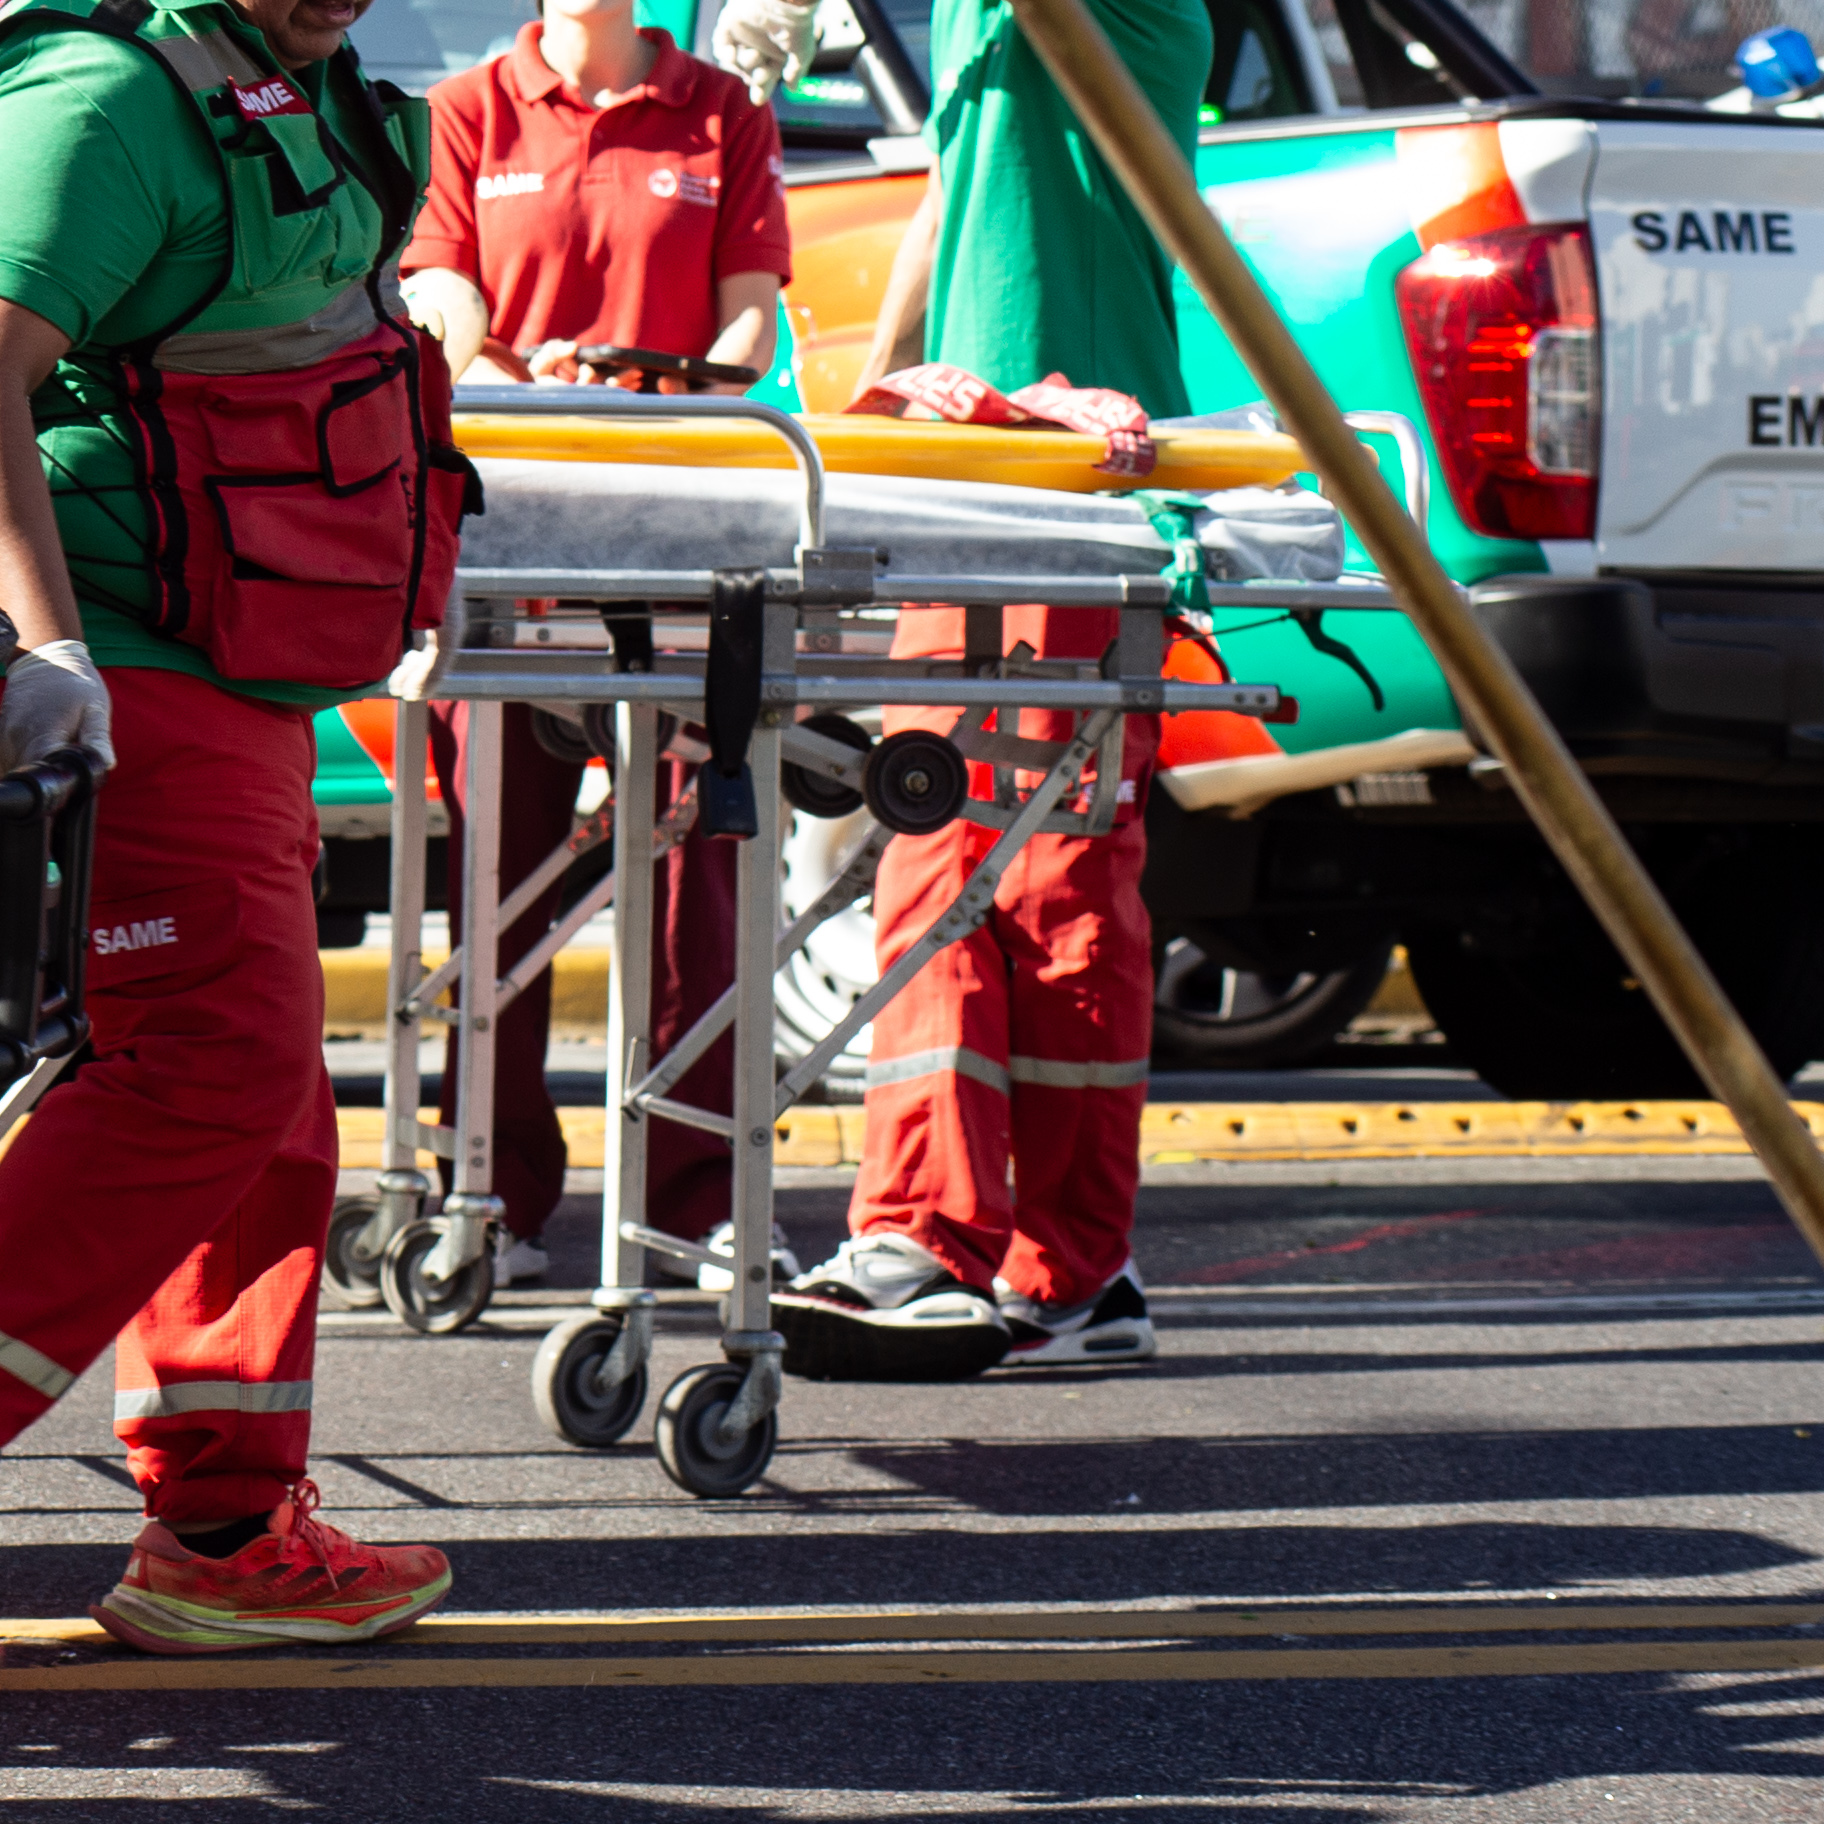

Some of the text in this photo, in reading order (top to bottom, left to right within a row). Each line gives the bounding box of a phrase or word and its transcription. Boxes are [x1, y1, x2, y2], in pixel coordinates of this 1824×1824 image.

[235, 82, 295, 114] SAME
[476, 172, 544, 200] SAME
[1631, 210, 1795, 254] SAME
[1748, 395, 1824, 447] EM
[92, 916, 179, 955] SAME
